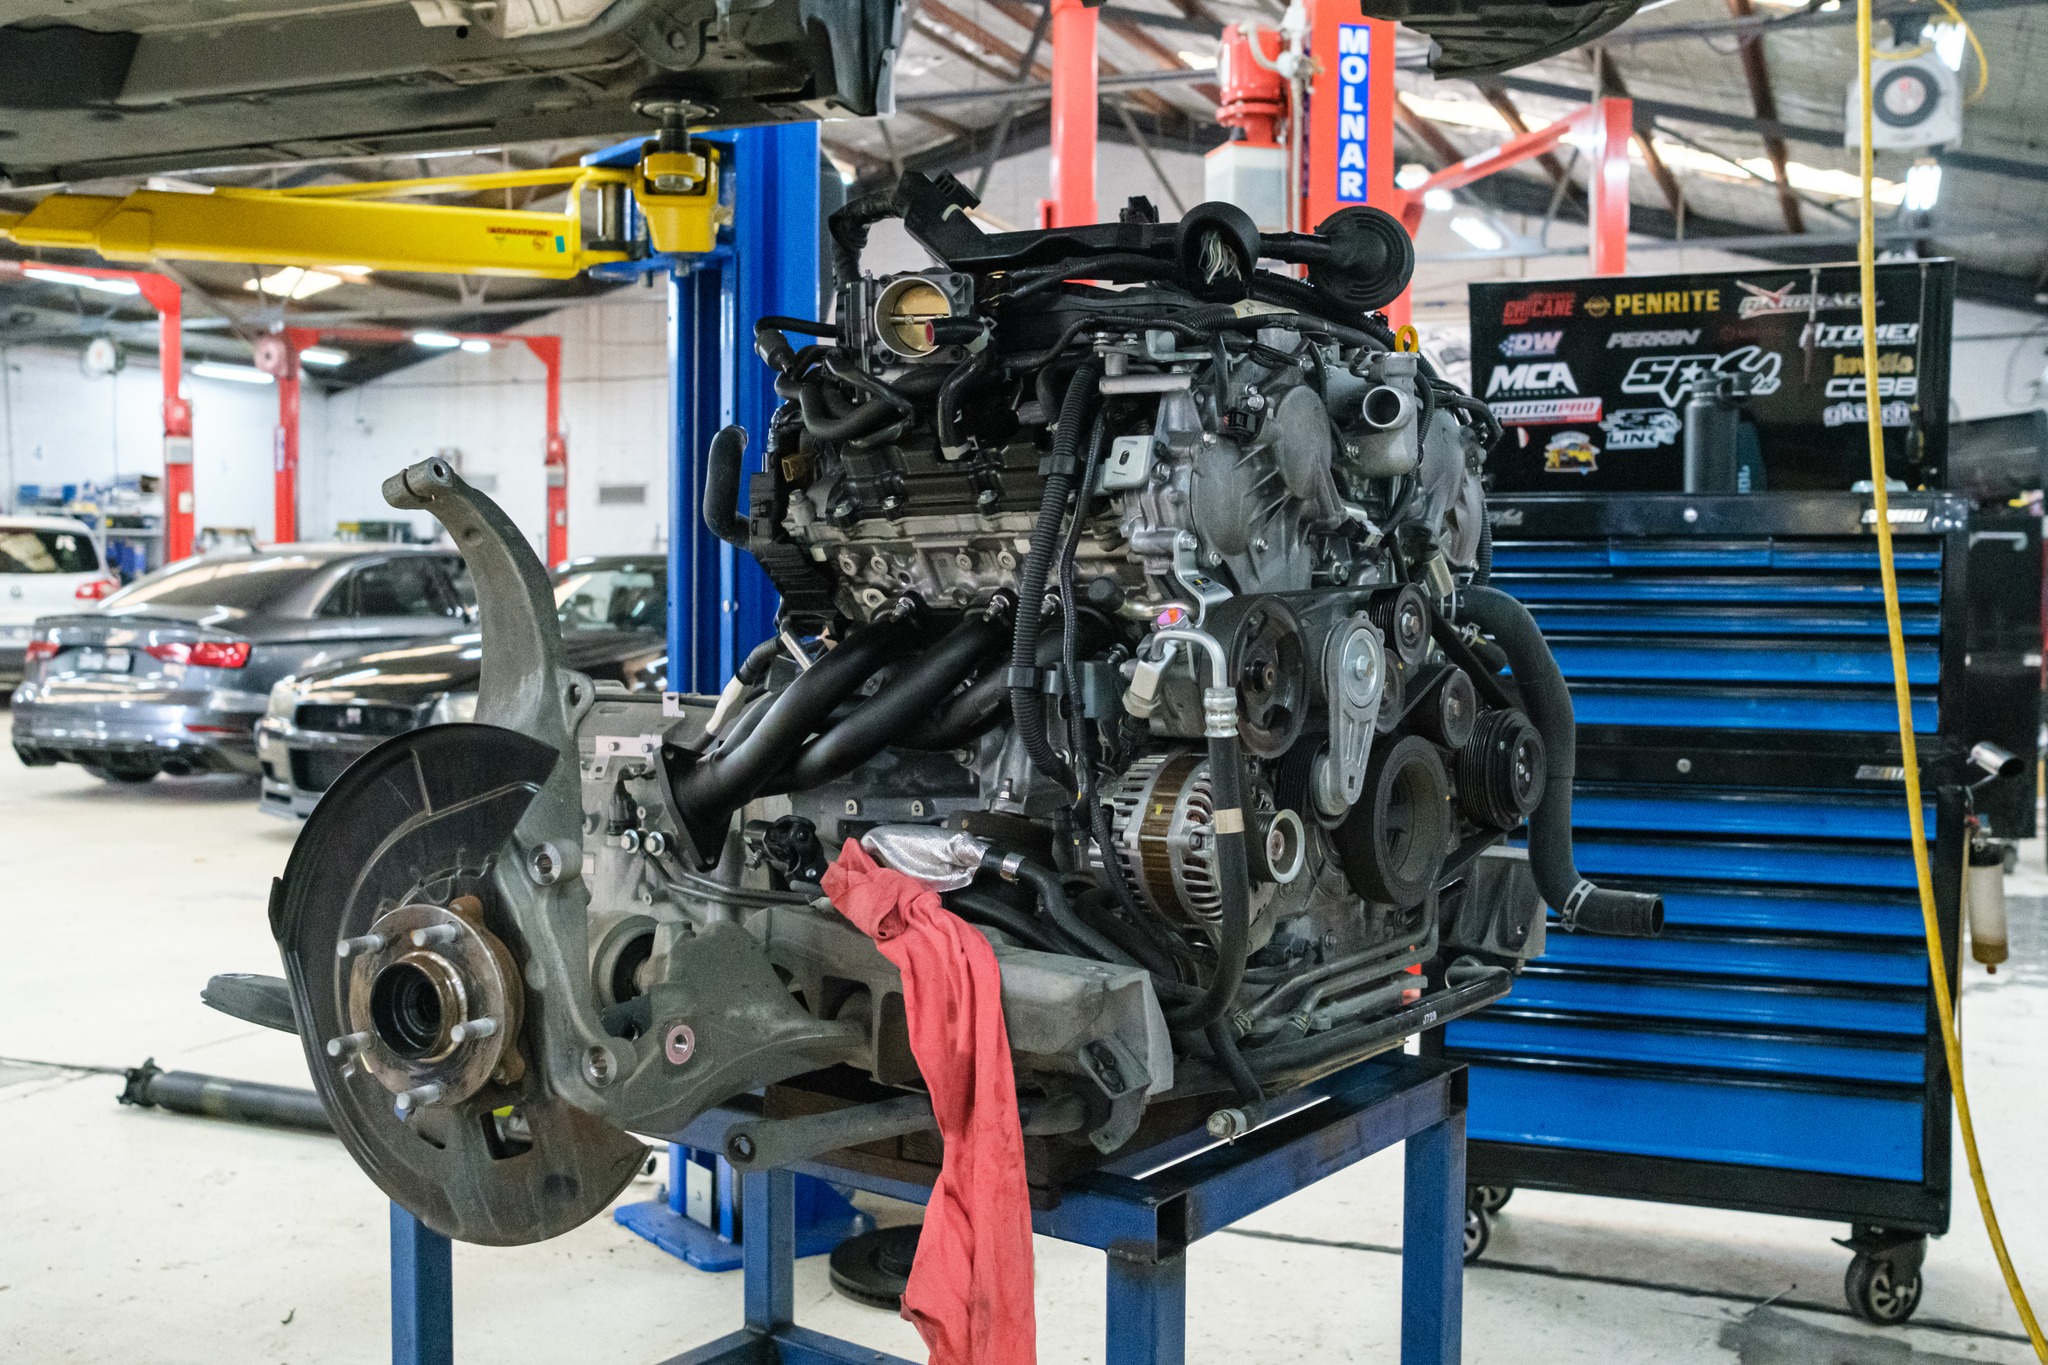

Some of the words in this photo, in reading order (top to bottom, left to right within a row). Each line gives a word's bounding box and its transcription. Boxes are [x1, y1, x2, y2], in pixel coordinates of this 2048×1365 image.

[1339, 27, 1369, 198] MOLNAR
[1615, 289, 1721, 316] PENRITE
[1513, 330, 1564, 352] DW
[1606, 328, 1702, 349] PERRIN
[1484, 361, 1579, 399] MCA
